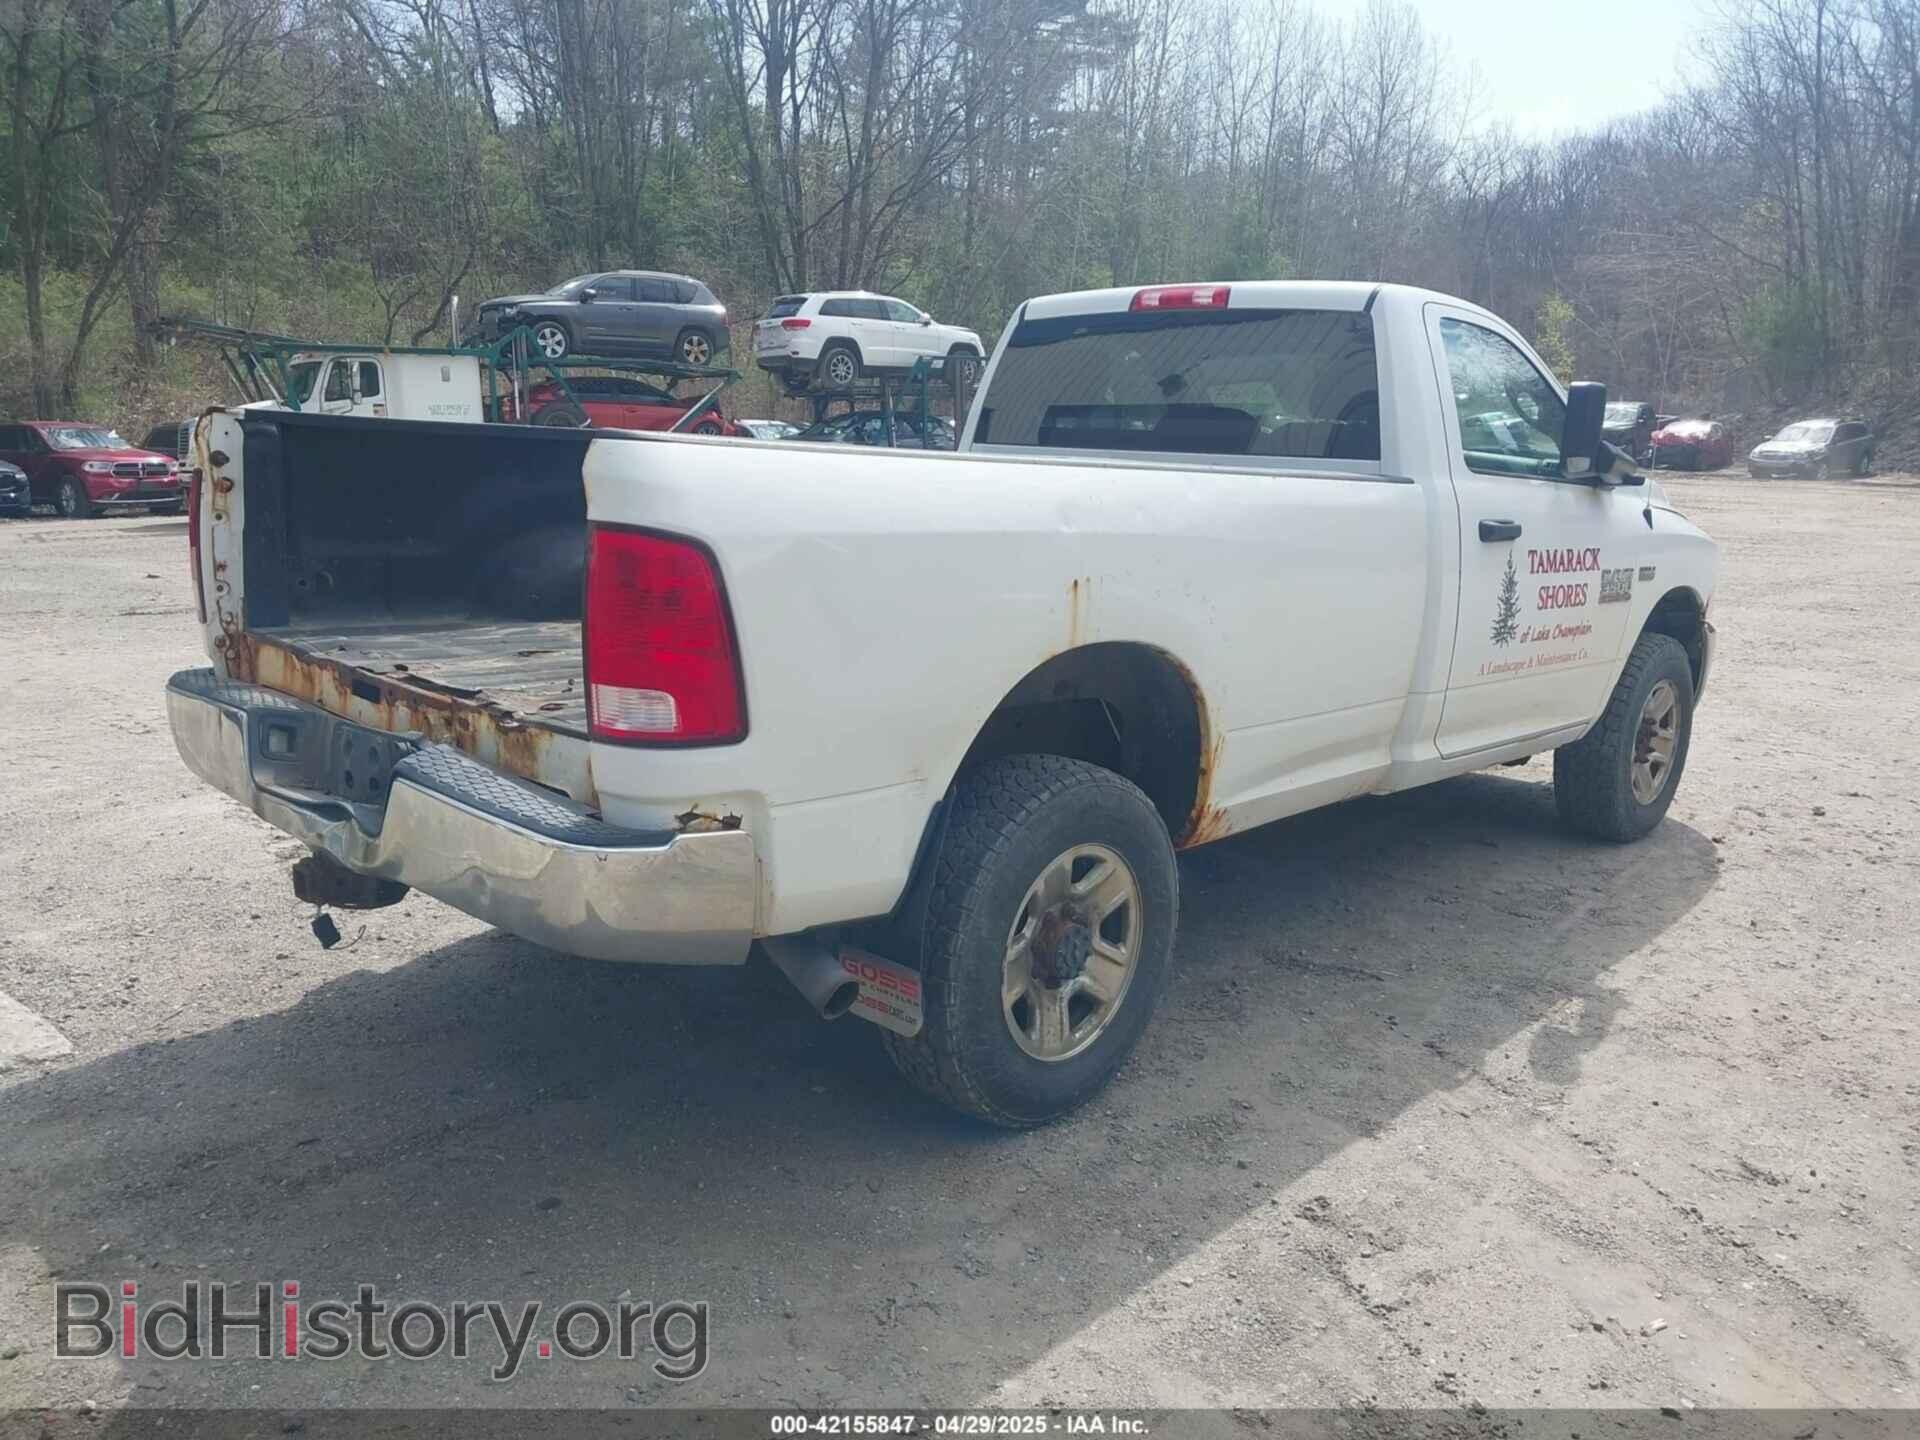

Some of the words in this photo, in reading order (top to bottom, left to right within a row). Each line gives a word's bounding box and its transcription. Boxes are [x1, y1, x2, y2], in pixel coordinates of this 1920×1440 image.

[1527, 547, 1601, 575] TAMARACK
[1536, 582, 1588, 610] SHORES
[1519, 625, 1531, 643] of
